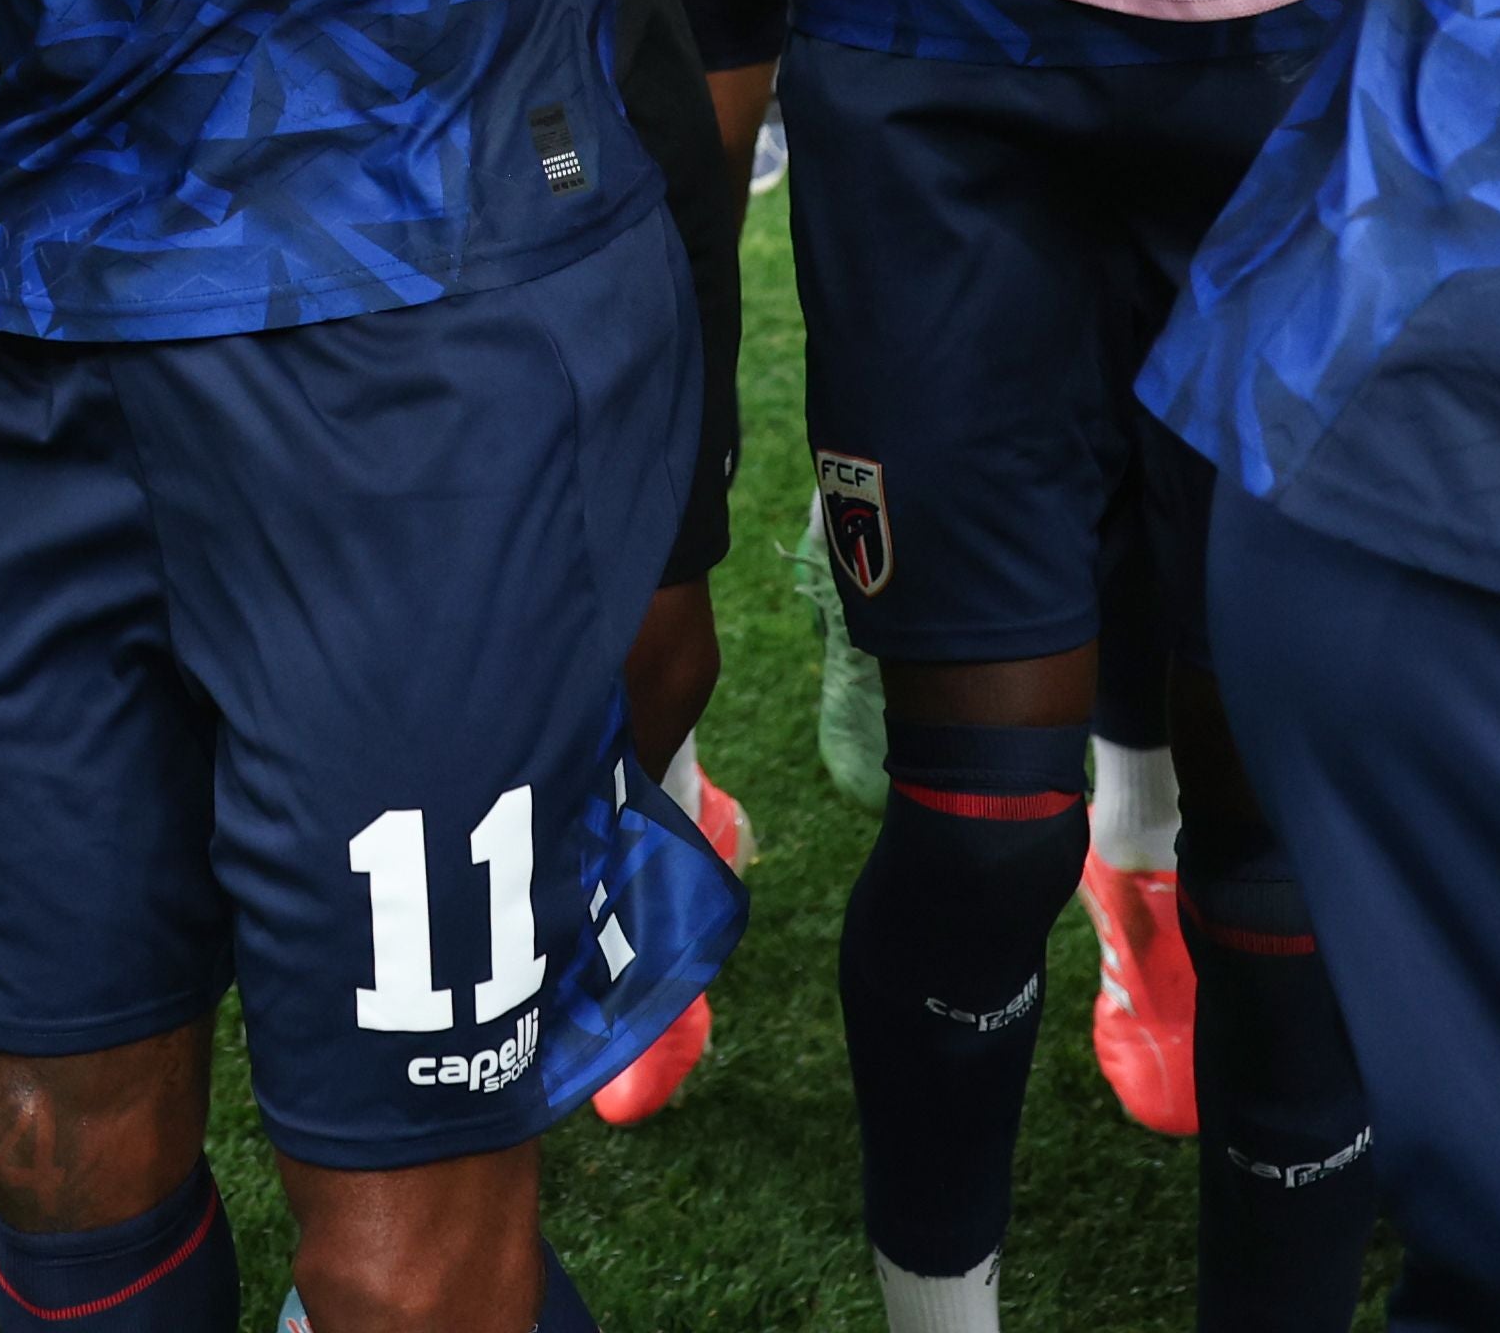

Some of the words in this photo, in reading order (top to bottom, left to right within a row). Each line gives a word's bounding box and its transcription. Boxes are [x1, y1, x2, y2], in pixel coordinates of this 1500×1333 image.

[542, 150, 576, 166] AUTHENTIC
[544, 157, 579, 174] LICENSED
[547, 165, 581, 180] PRODUCT
[821, 459, 874, 488] FCF
[348, 783, 547, 1032] 11
[407, 1006, 540, 1093] capelli
[483, 1046, 537, 1094] SPORT
